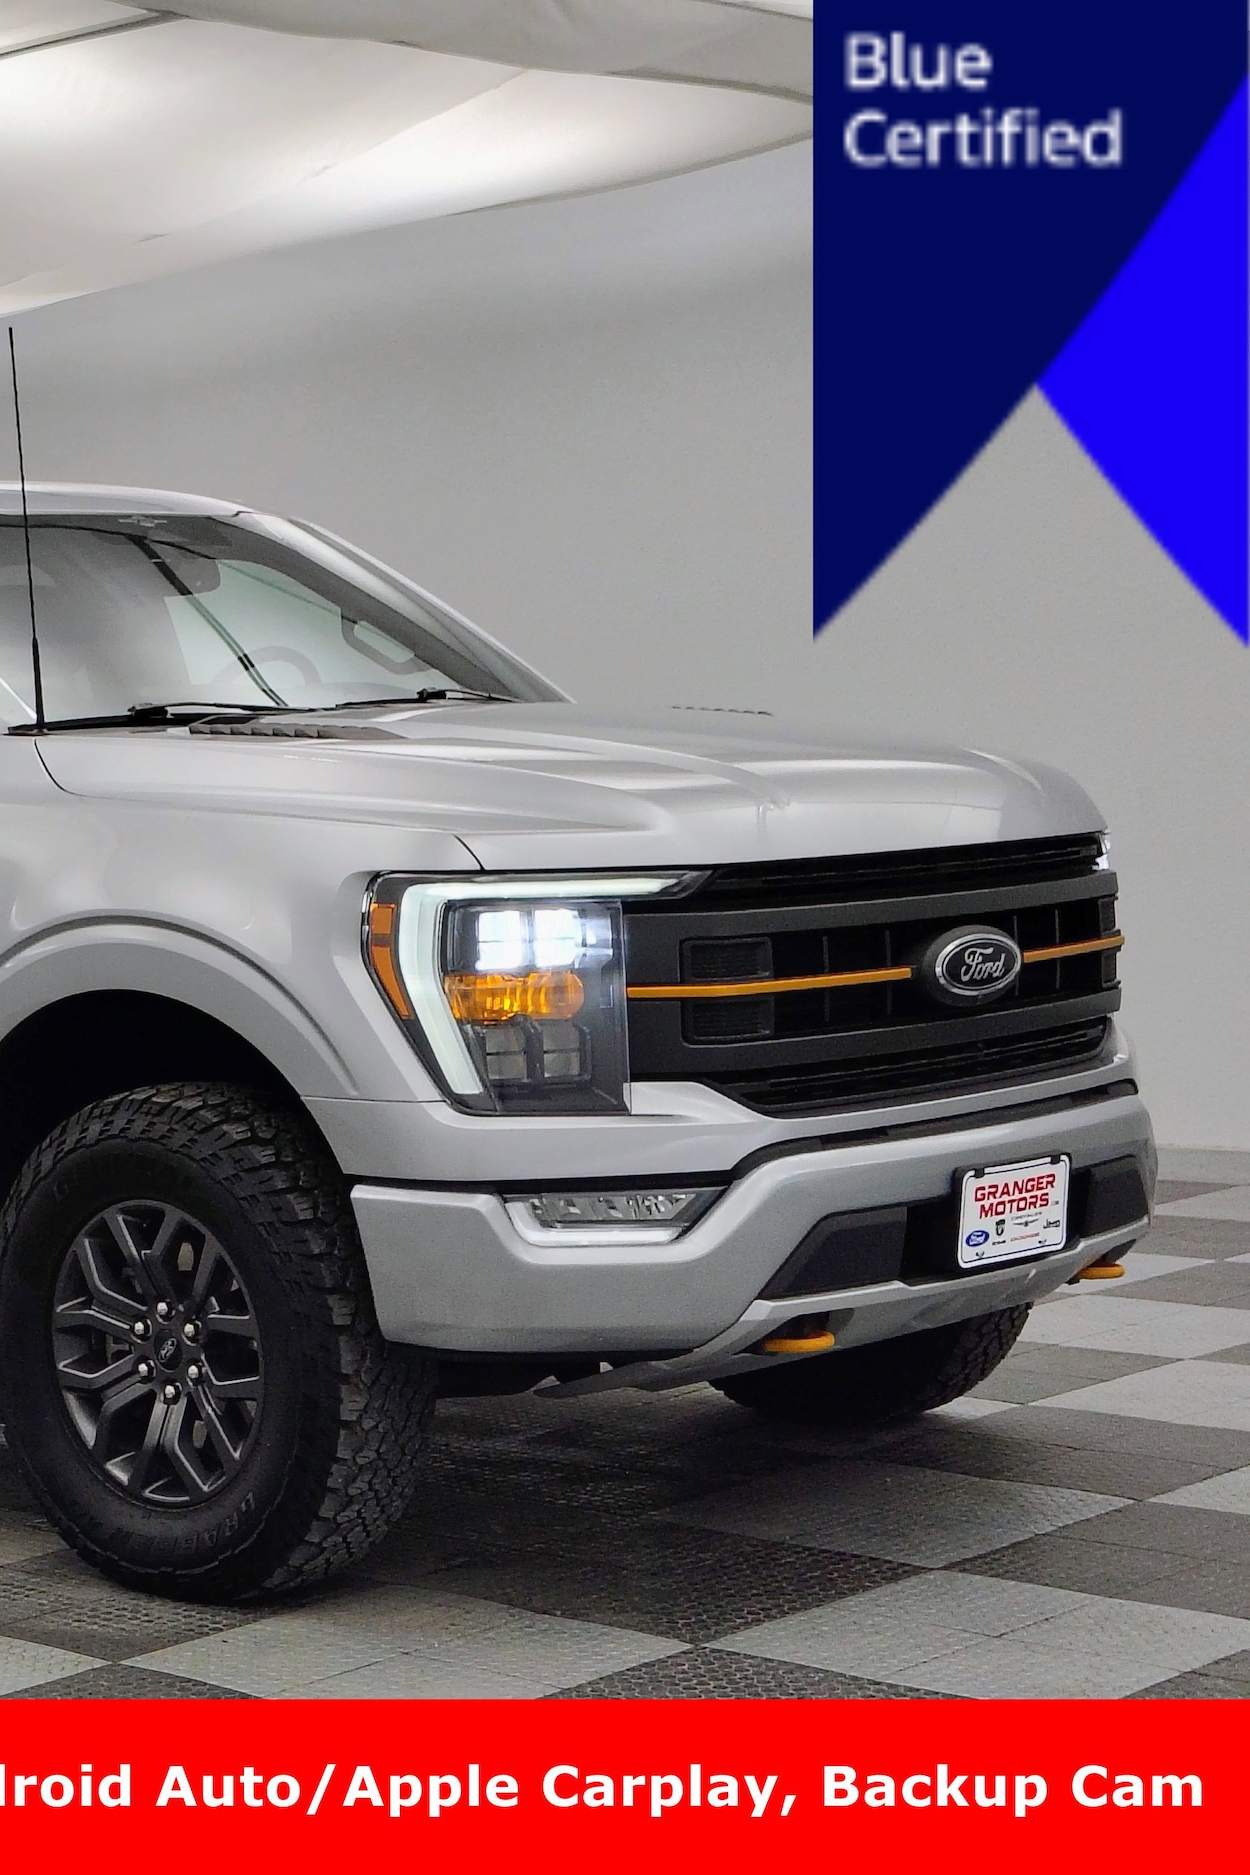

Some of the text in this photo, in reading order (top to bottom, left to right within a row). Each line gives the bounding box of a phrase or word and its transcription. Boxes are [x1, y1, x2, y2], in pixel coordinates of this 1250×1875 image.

[960, 946, 1006, 982] Ford
[974, 1173, 1056, 1202] GRANGER
[979, 1192, 1049, 1219] MOTORS
